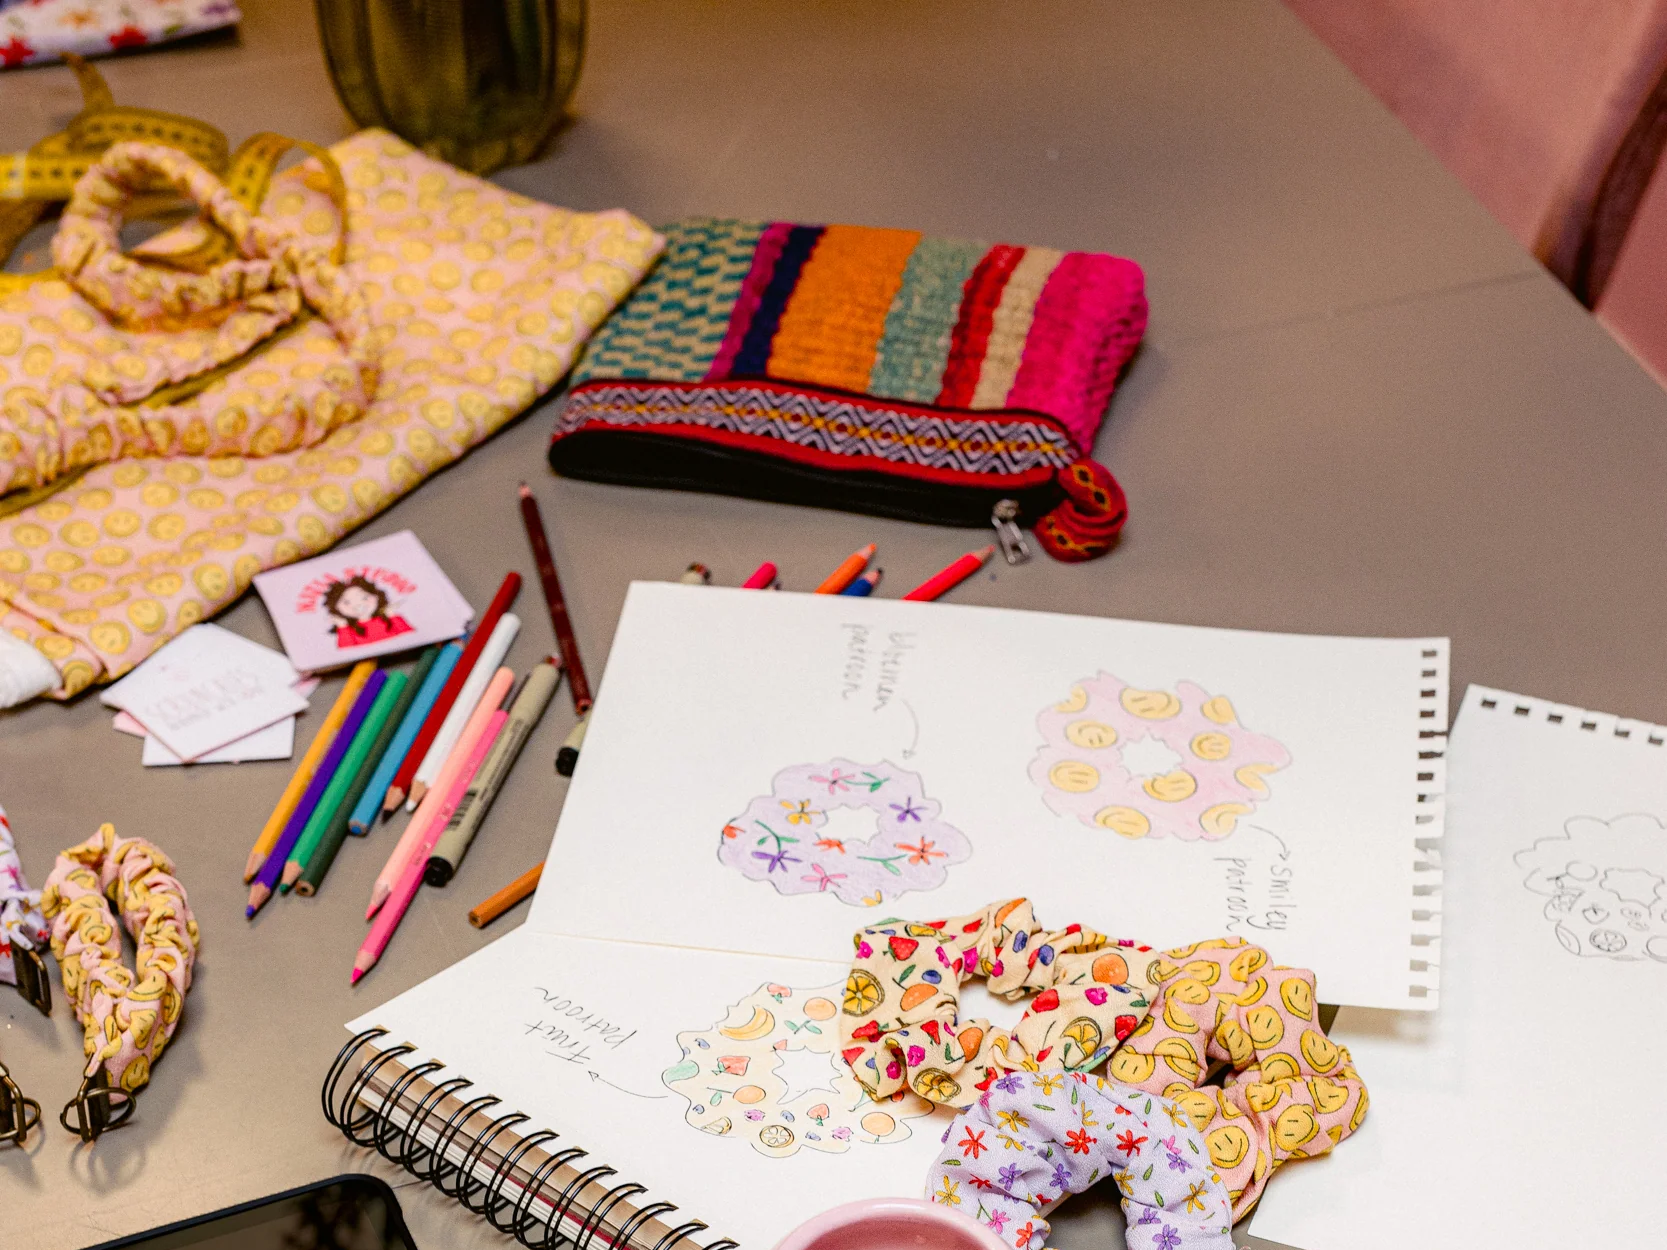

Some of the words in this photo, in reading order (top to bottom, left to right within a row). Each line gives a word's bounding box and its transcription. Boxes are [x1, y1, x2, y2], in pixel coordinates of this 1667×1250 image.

[1212, 856, 1253, 932] patroon
[1246, 864, 1298, 931] smiley
[524, 1020, 591, 1065] Fruit
[533, 987, 637, 1050] patroon
